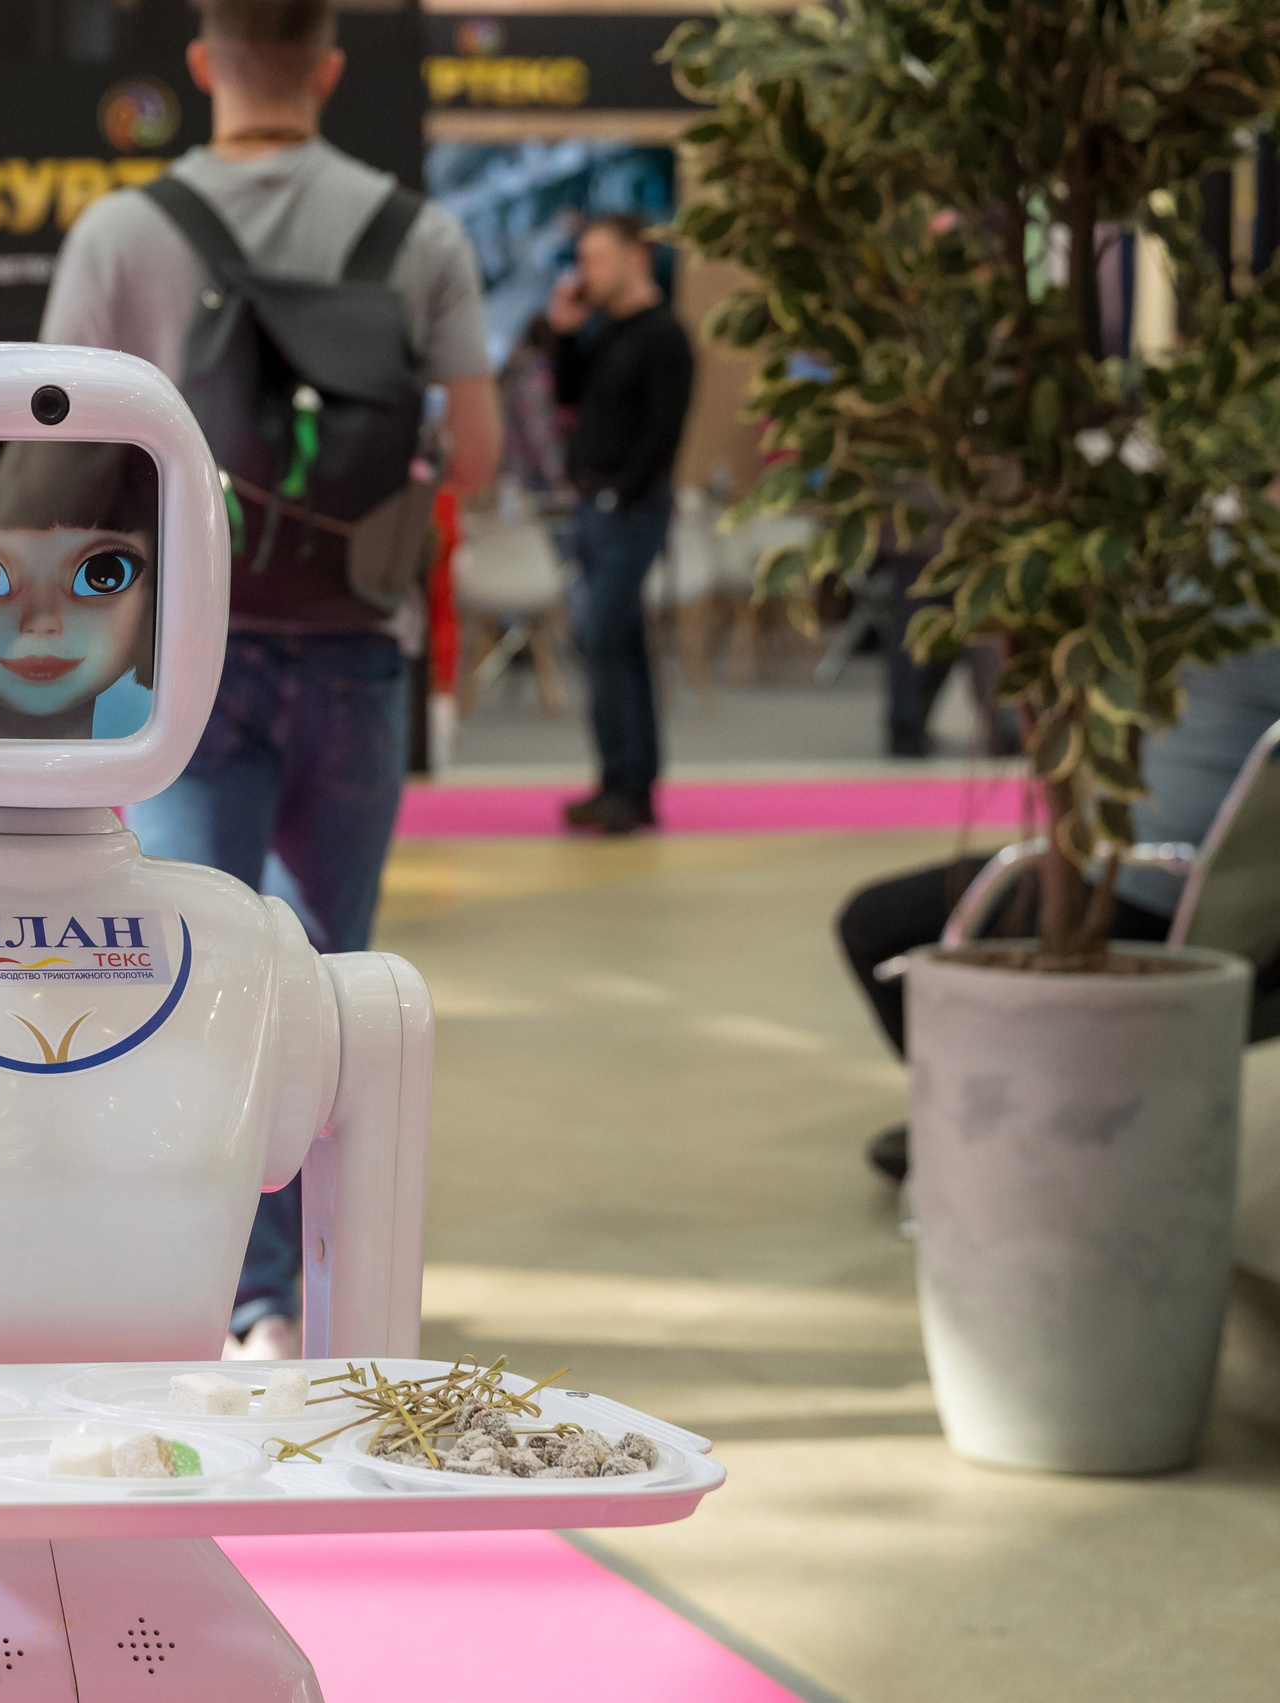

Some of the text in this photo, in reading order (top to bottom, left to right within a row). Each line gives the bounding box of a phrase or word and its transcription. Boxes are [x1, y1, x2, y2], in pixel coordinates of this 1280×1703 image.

[422, 57, 589, 103] РТЕКС
[93, 952, 151, 967] текс
[43, 972, 111, 980] ТРИКОТАЖНОГО
